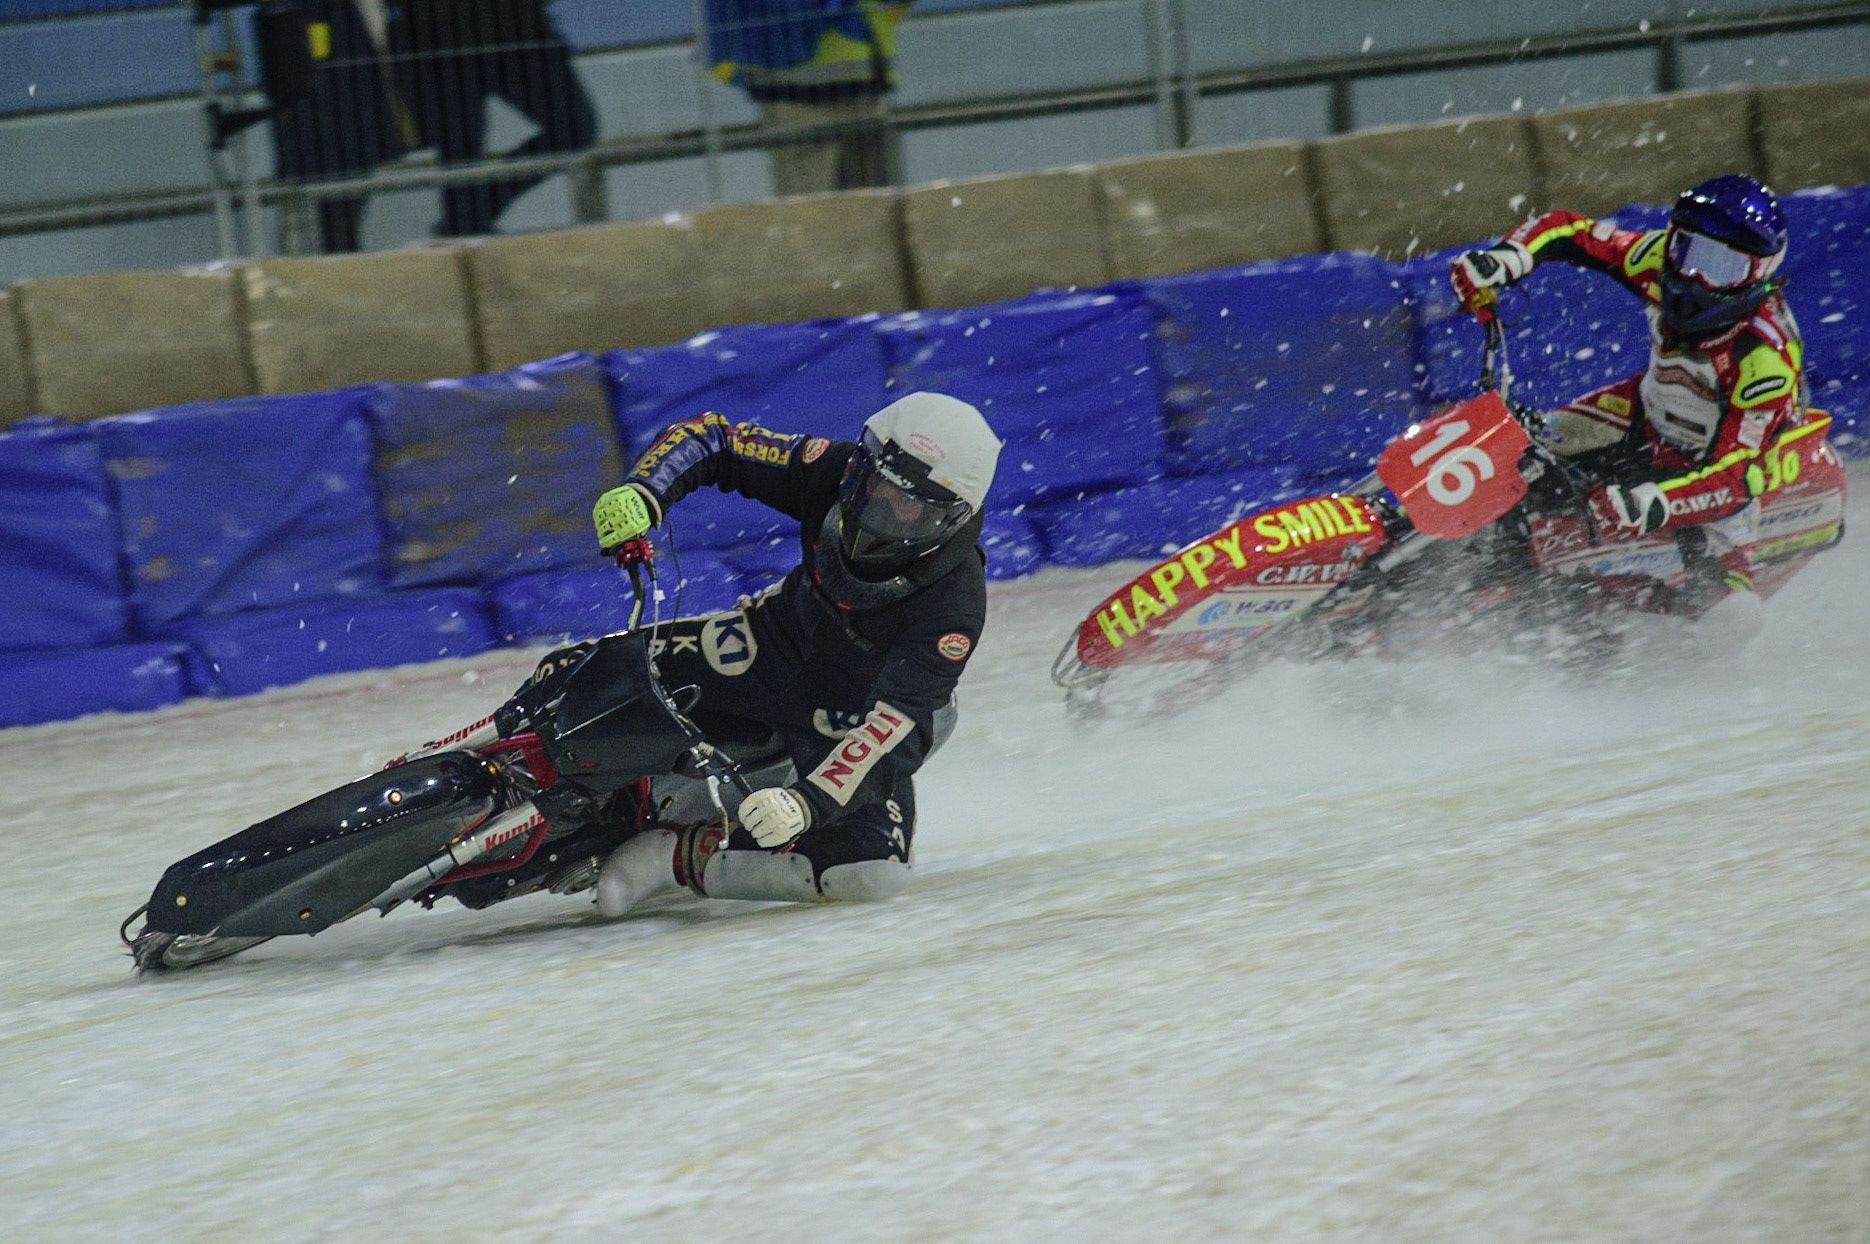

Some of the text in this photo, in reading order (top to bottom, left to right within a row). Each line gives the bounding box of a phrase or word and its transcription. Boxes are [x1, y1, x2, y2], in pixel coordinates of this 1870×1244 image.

[1410, 420, 1495, 506] 16
[1096, 496, 1371, 648] HAPPY SMILE
